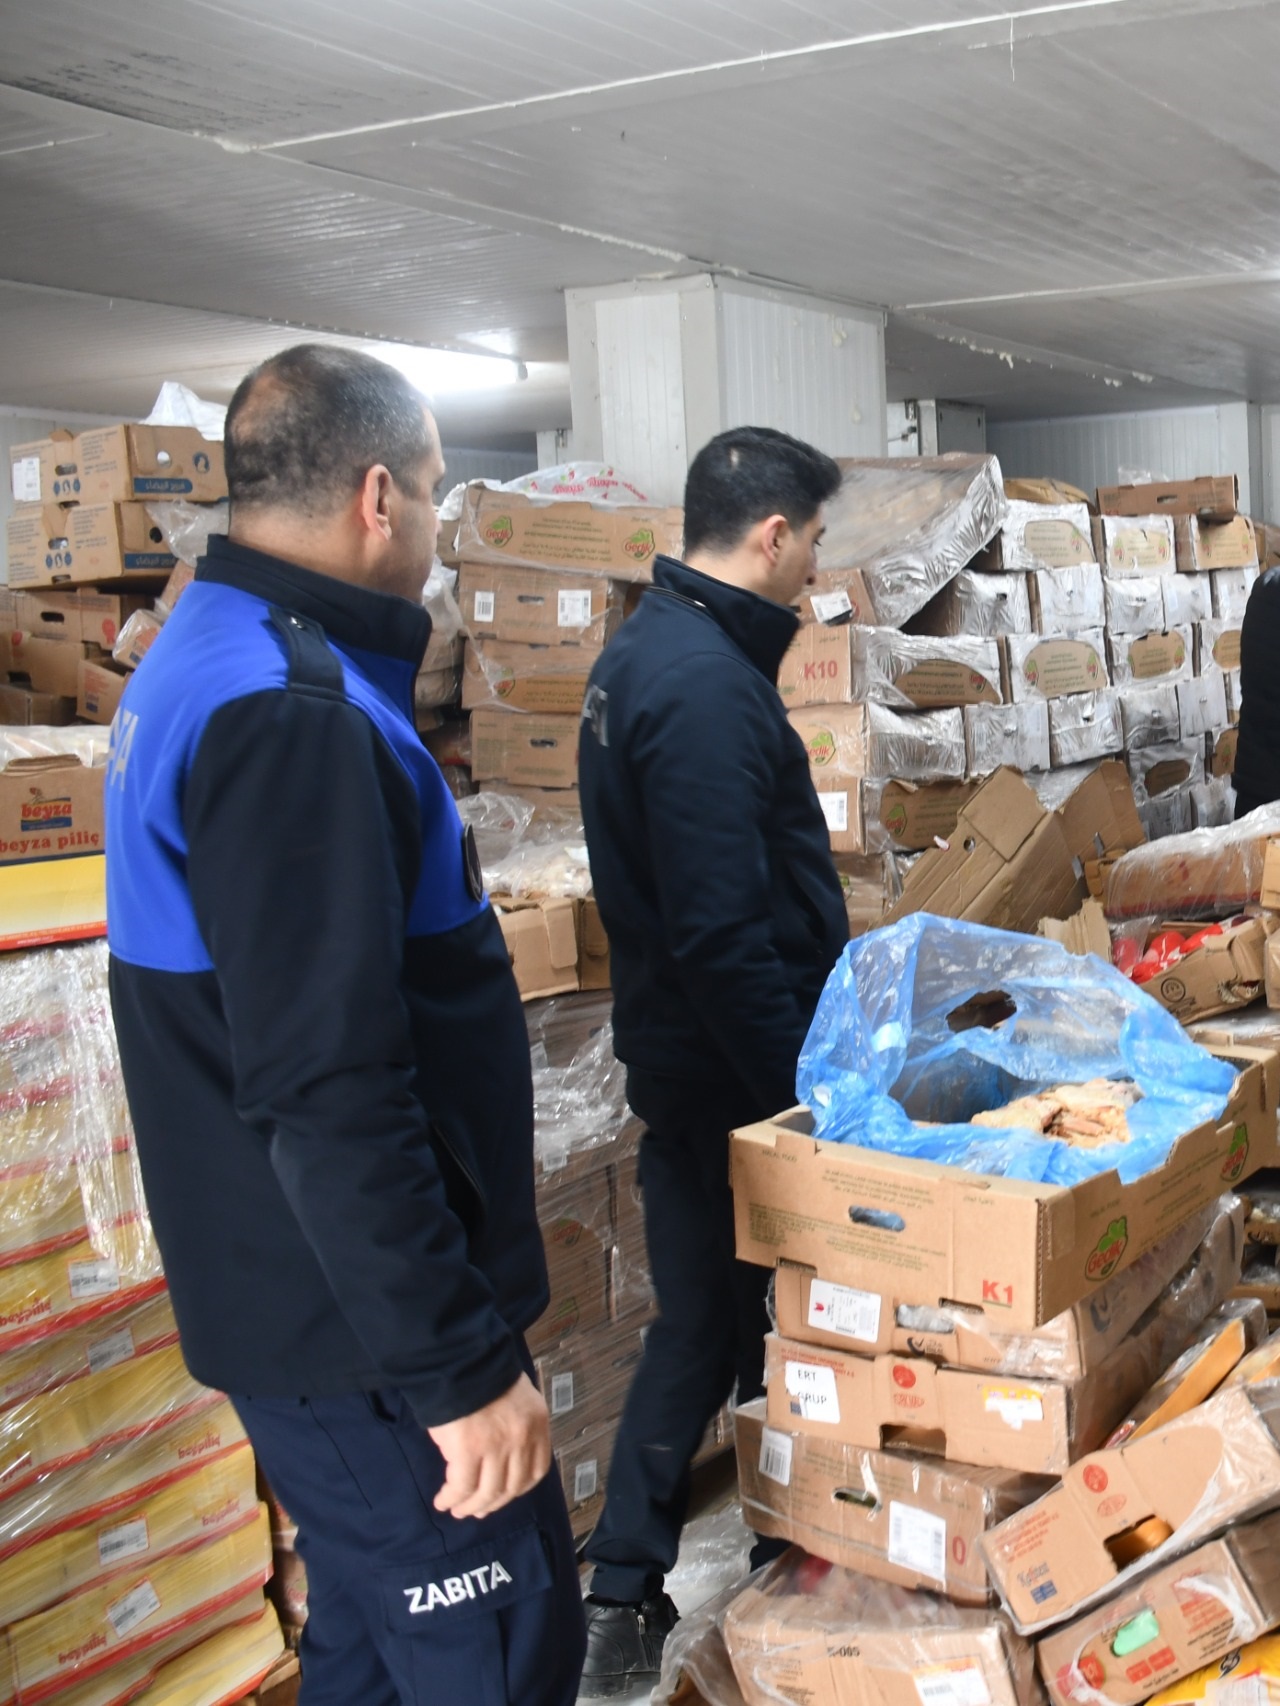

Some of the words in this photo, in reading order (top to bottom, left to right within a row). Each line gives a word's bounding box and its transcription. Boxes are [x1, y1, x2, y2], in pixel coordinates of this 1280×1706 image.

[804, 660, 838, 680] K10
[21, 803, 72, 819] beyza
[57, 831, 100, 848] piliç
[982, 1279, 1013, 1304] K1
[403, 1560, 513, 1614] ZABITA
